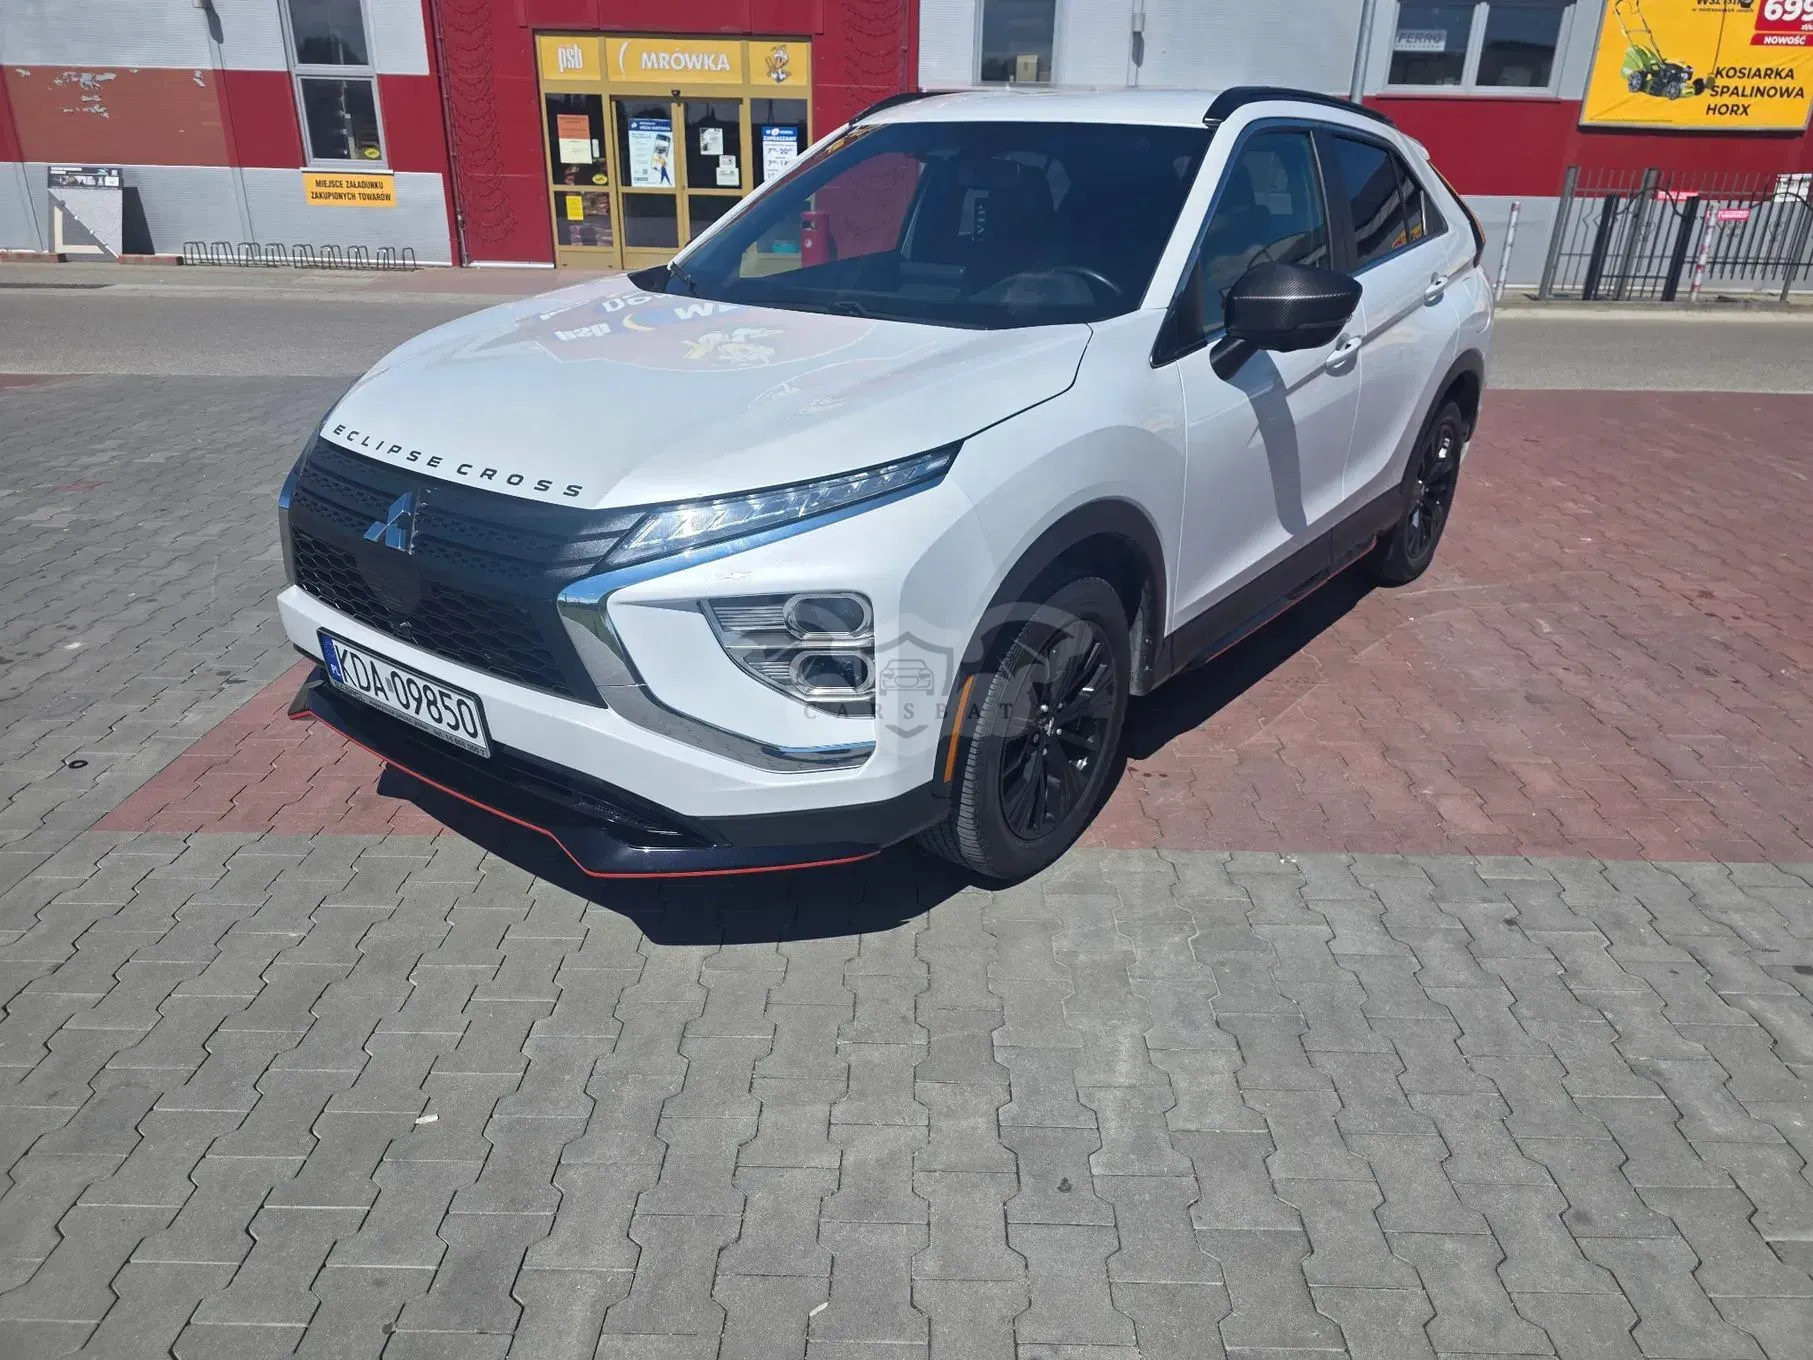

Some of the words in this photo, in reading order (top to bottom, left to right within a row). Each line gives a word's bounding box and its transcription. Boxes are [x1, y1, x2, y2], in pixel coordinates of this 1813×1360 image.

[1763, 35, 1806, 45] NOWOŚĆ
[557, 44, 583, 73] psb
[641, 48, 730, 71] MRÓWKA
[1714, 67, 1795, 80] KOSIARKA
[1709, 85, 1805, 98] SPALINOWA
[1705, 104, 1751, 116] HORX
[315, 179, 343, 188] MIEJSCE
[346, 180, 384, 189] ZAŁADUNKU
[311, 191, 356, 201] ZAKUPIONYCH
[358, 190, 391, 201] TOWARÓW
[333, 424, 443, 468] ECLIPSE
[456, 463, 583, 497] CROSS
[335, 645, 390, 701] KDA
[390, 670, 479, 739] 09850
